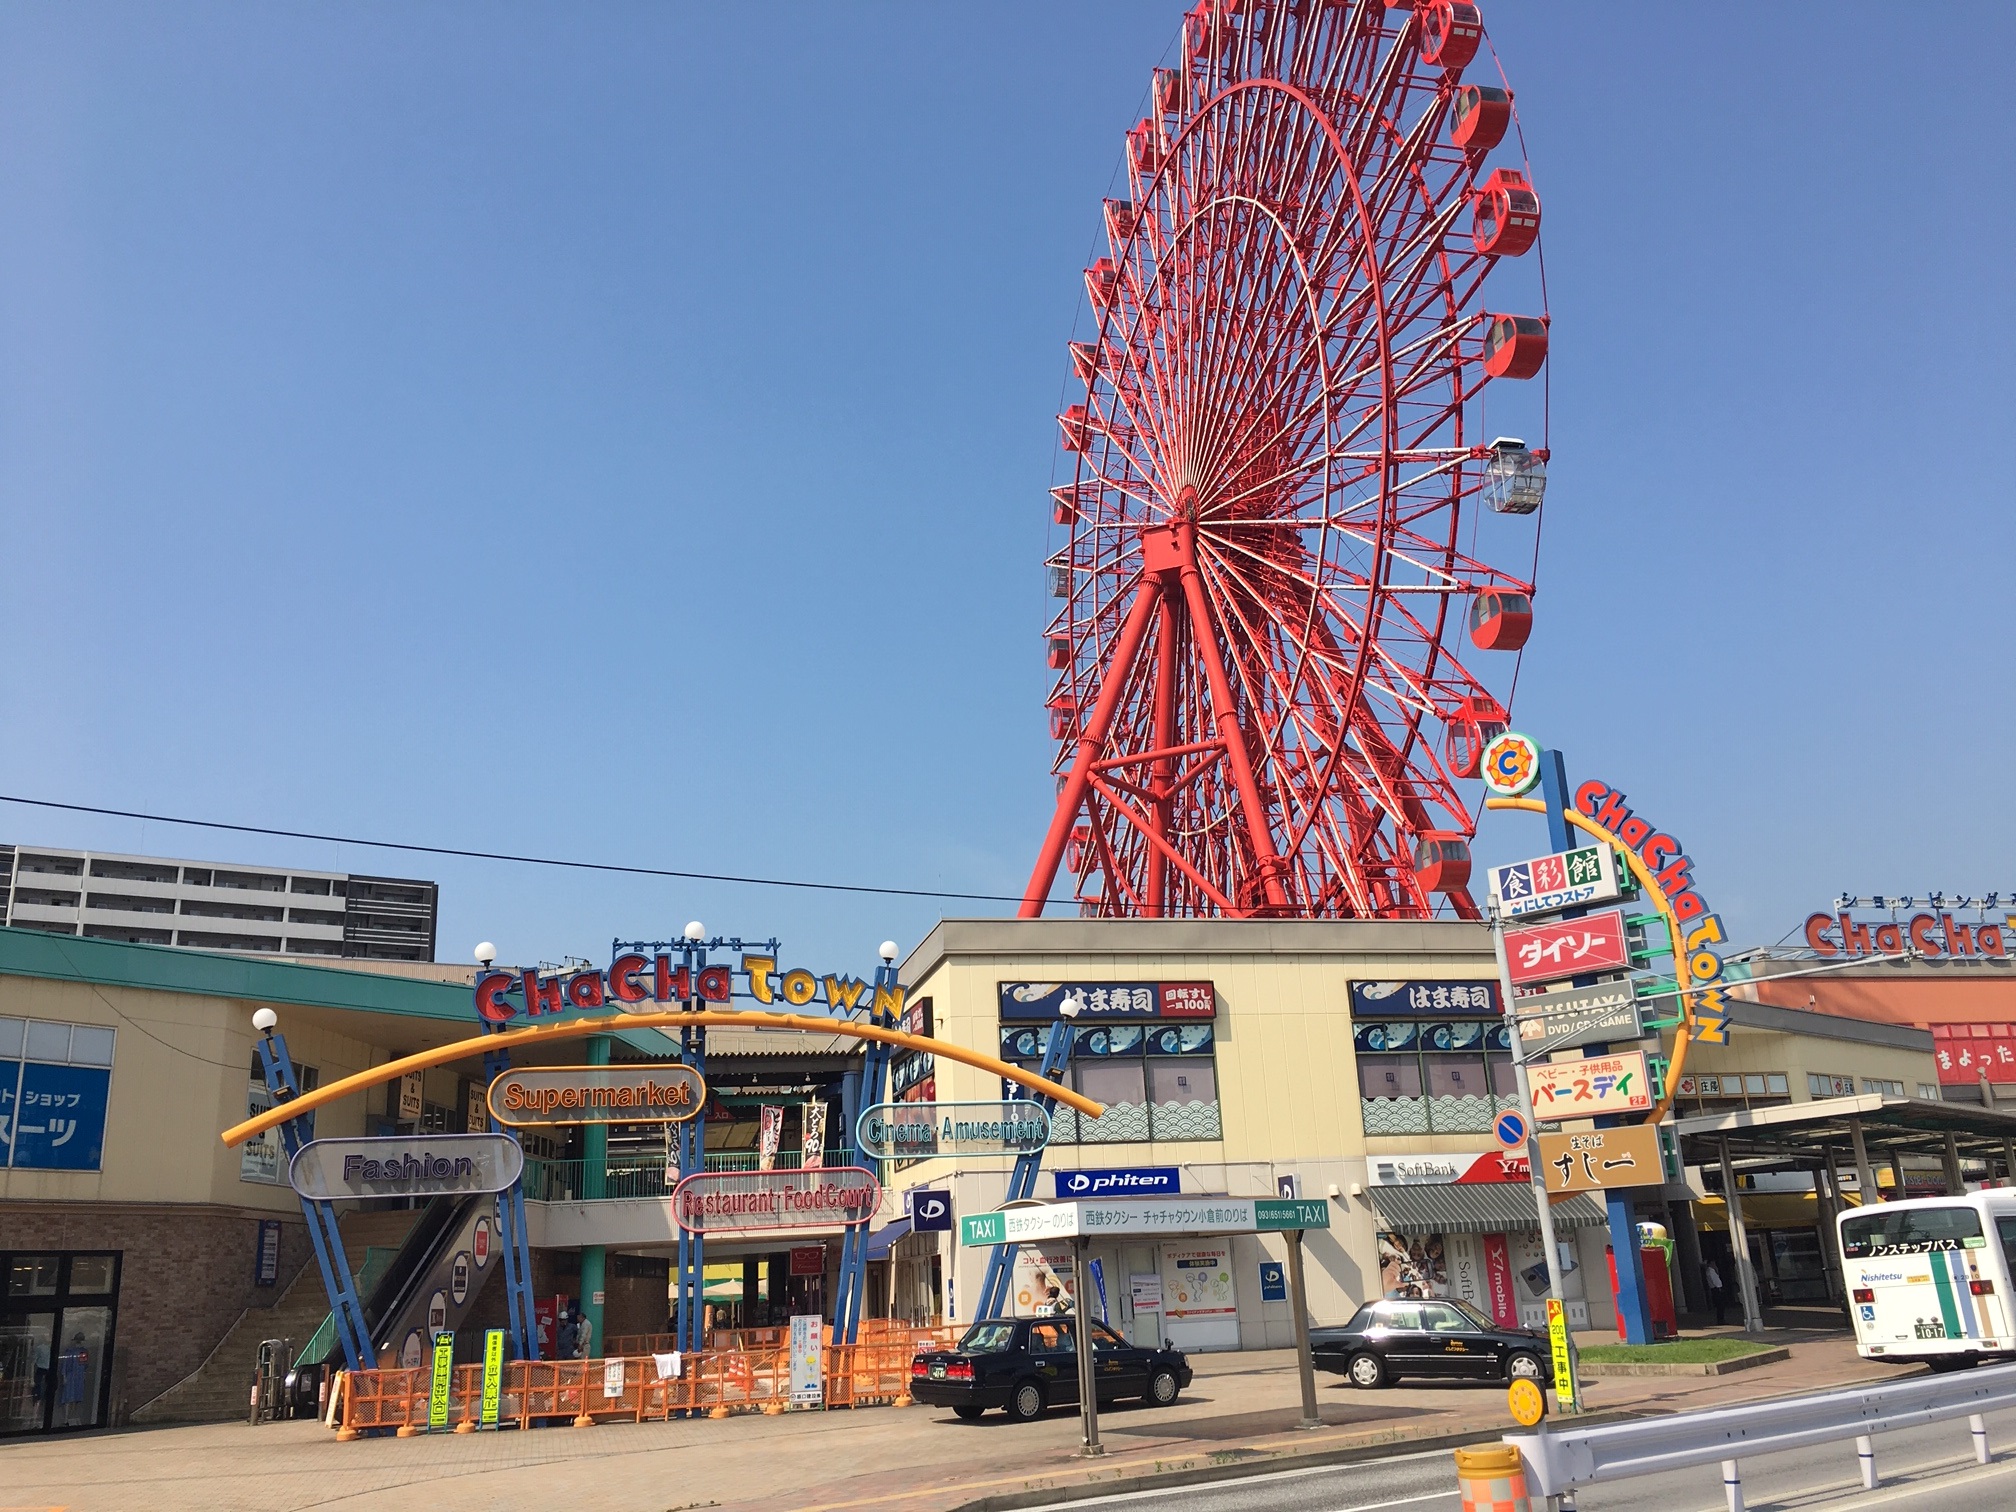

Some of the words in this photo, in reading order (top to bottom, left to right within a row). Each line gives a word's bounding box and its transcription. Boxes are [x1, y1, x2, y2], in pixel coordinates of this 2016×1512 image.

[1502, 851, 1598, 898] 食彩館
[1524, 886, 1595, 911] にしてつストア
[1519, 932, 1606, 968] ダイソー
[1064, 987, 1153, 1012] はま寿司
[1165, 988, 1211, 1001] 回転すし
[1409, 985, 1491, 1009] はま寿司
[1937, 1045, 2015, 1070] まよった
[1537, 1060, 1624, 1080] ベビー・子供用品
[402, 1095, 420, 1109] SUITS
[470, 1090, 486, 1103] SUITS
[504, 1080, 690, 1115] Supermarket
[1631, 1097, 1645, 1106] 2F
[867, 1118, 933, 1143] Cinema
[941, 1116, 1045, 1140] Amusement
[246, 1141, 275, 1159] SUITS
[1570, 1133, 1604, 1151] 生そば
[343, 1152, 473, 1181] Fashion
[1397, 1161, 1458, 1177] SoftBank
[1093, 1174, 1169, 1191] phiten
[683, 1187, 776, 1217] Restaurant
[1052, 1210, 1075, 1228] のりば
[1085, 1209, 1138, 1226] 西鉄タクシー
[1143, 1208, 1249, 1225] チャチャタウン小倉前のりば
[1296, 1205, 1326, 1223] TAXI
[969, 1218, 997, 1239] TAXI
[1869, 1239, 1959, 1257] ノンステップバス
[1861, 1272, 1903, 1283] Nishitetsu
[1552, 1324, 1564, 1334] 200
[1921, 1328, 1944, 1338] 10-17
[1555, 1345, 1569, 1390] 工事中
[483, 1365, 498, 1411] 立入禁止
